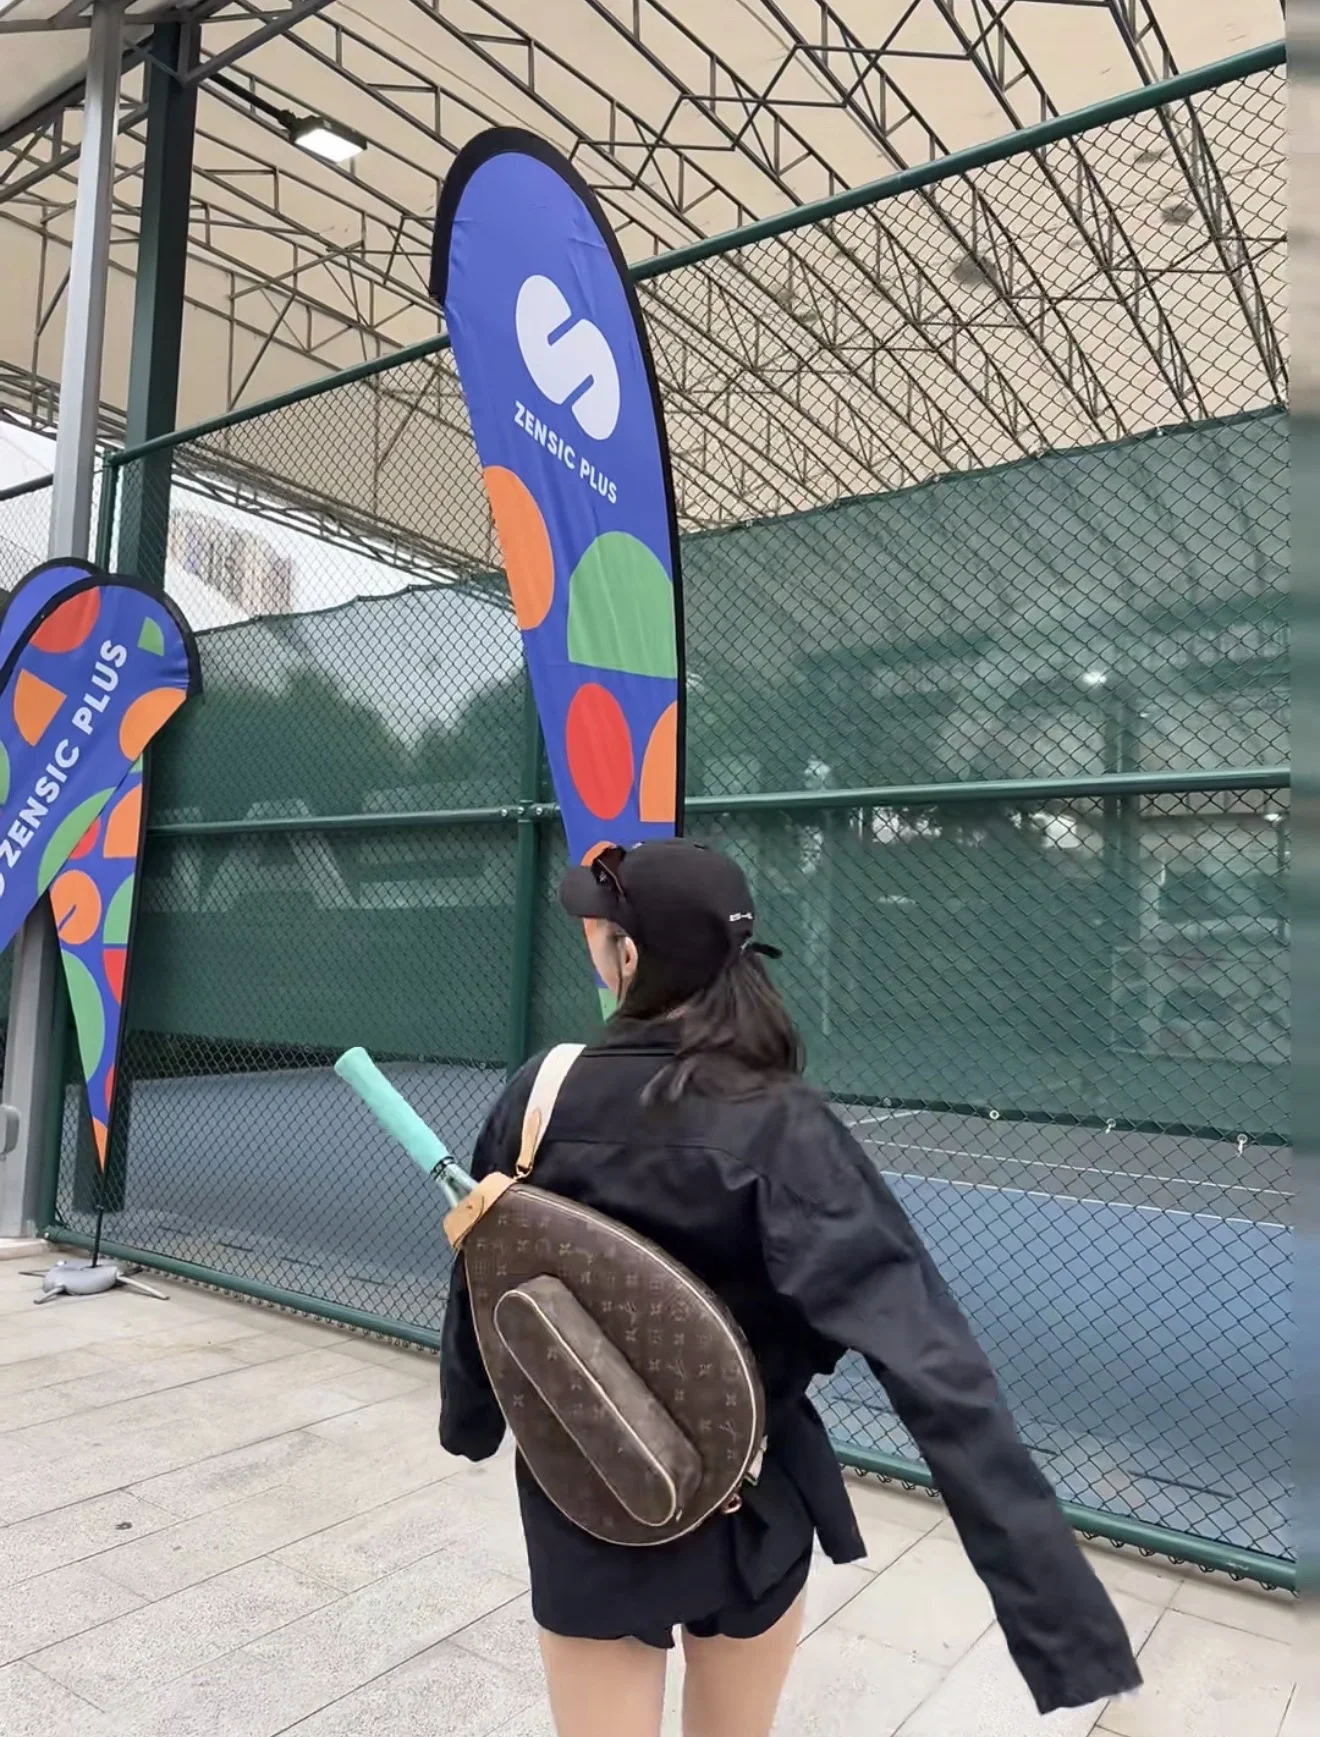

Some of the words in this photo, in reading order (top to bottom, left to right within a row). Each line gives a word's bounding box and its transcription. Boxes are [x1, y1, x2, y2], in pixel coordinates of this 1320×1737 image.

[514, 401, 576, 470] ZENSIC
[579, 457, 617, 504] PLUS
[1, 738, 80, 868] ZENSIC
[71, 639, 127, 735] PLUS
